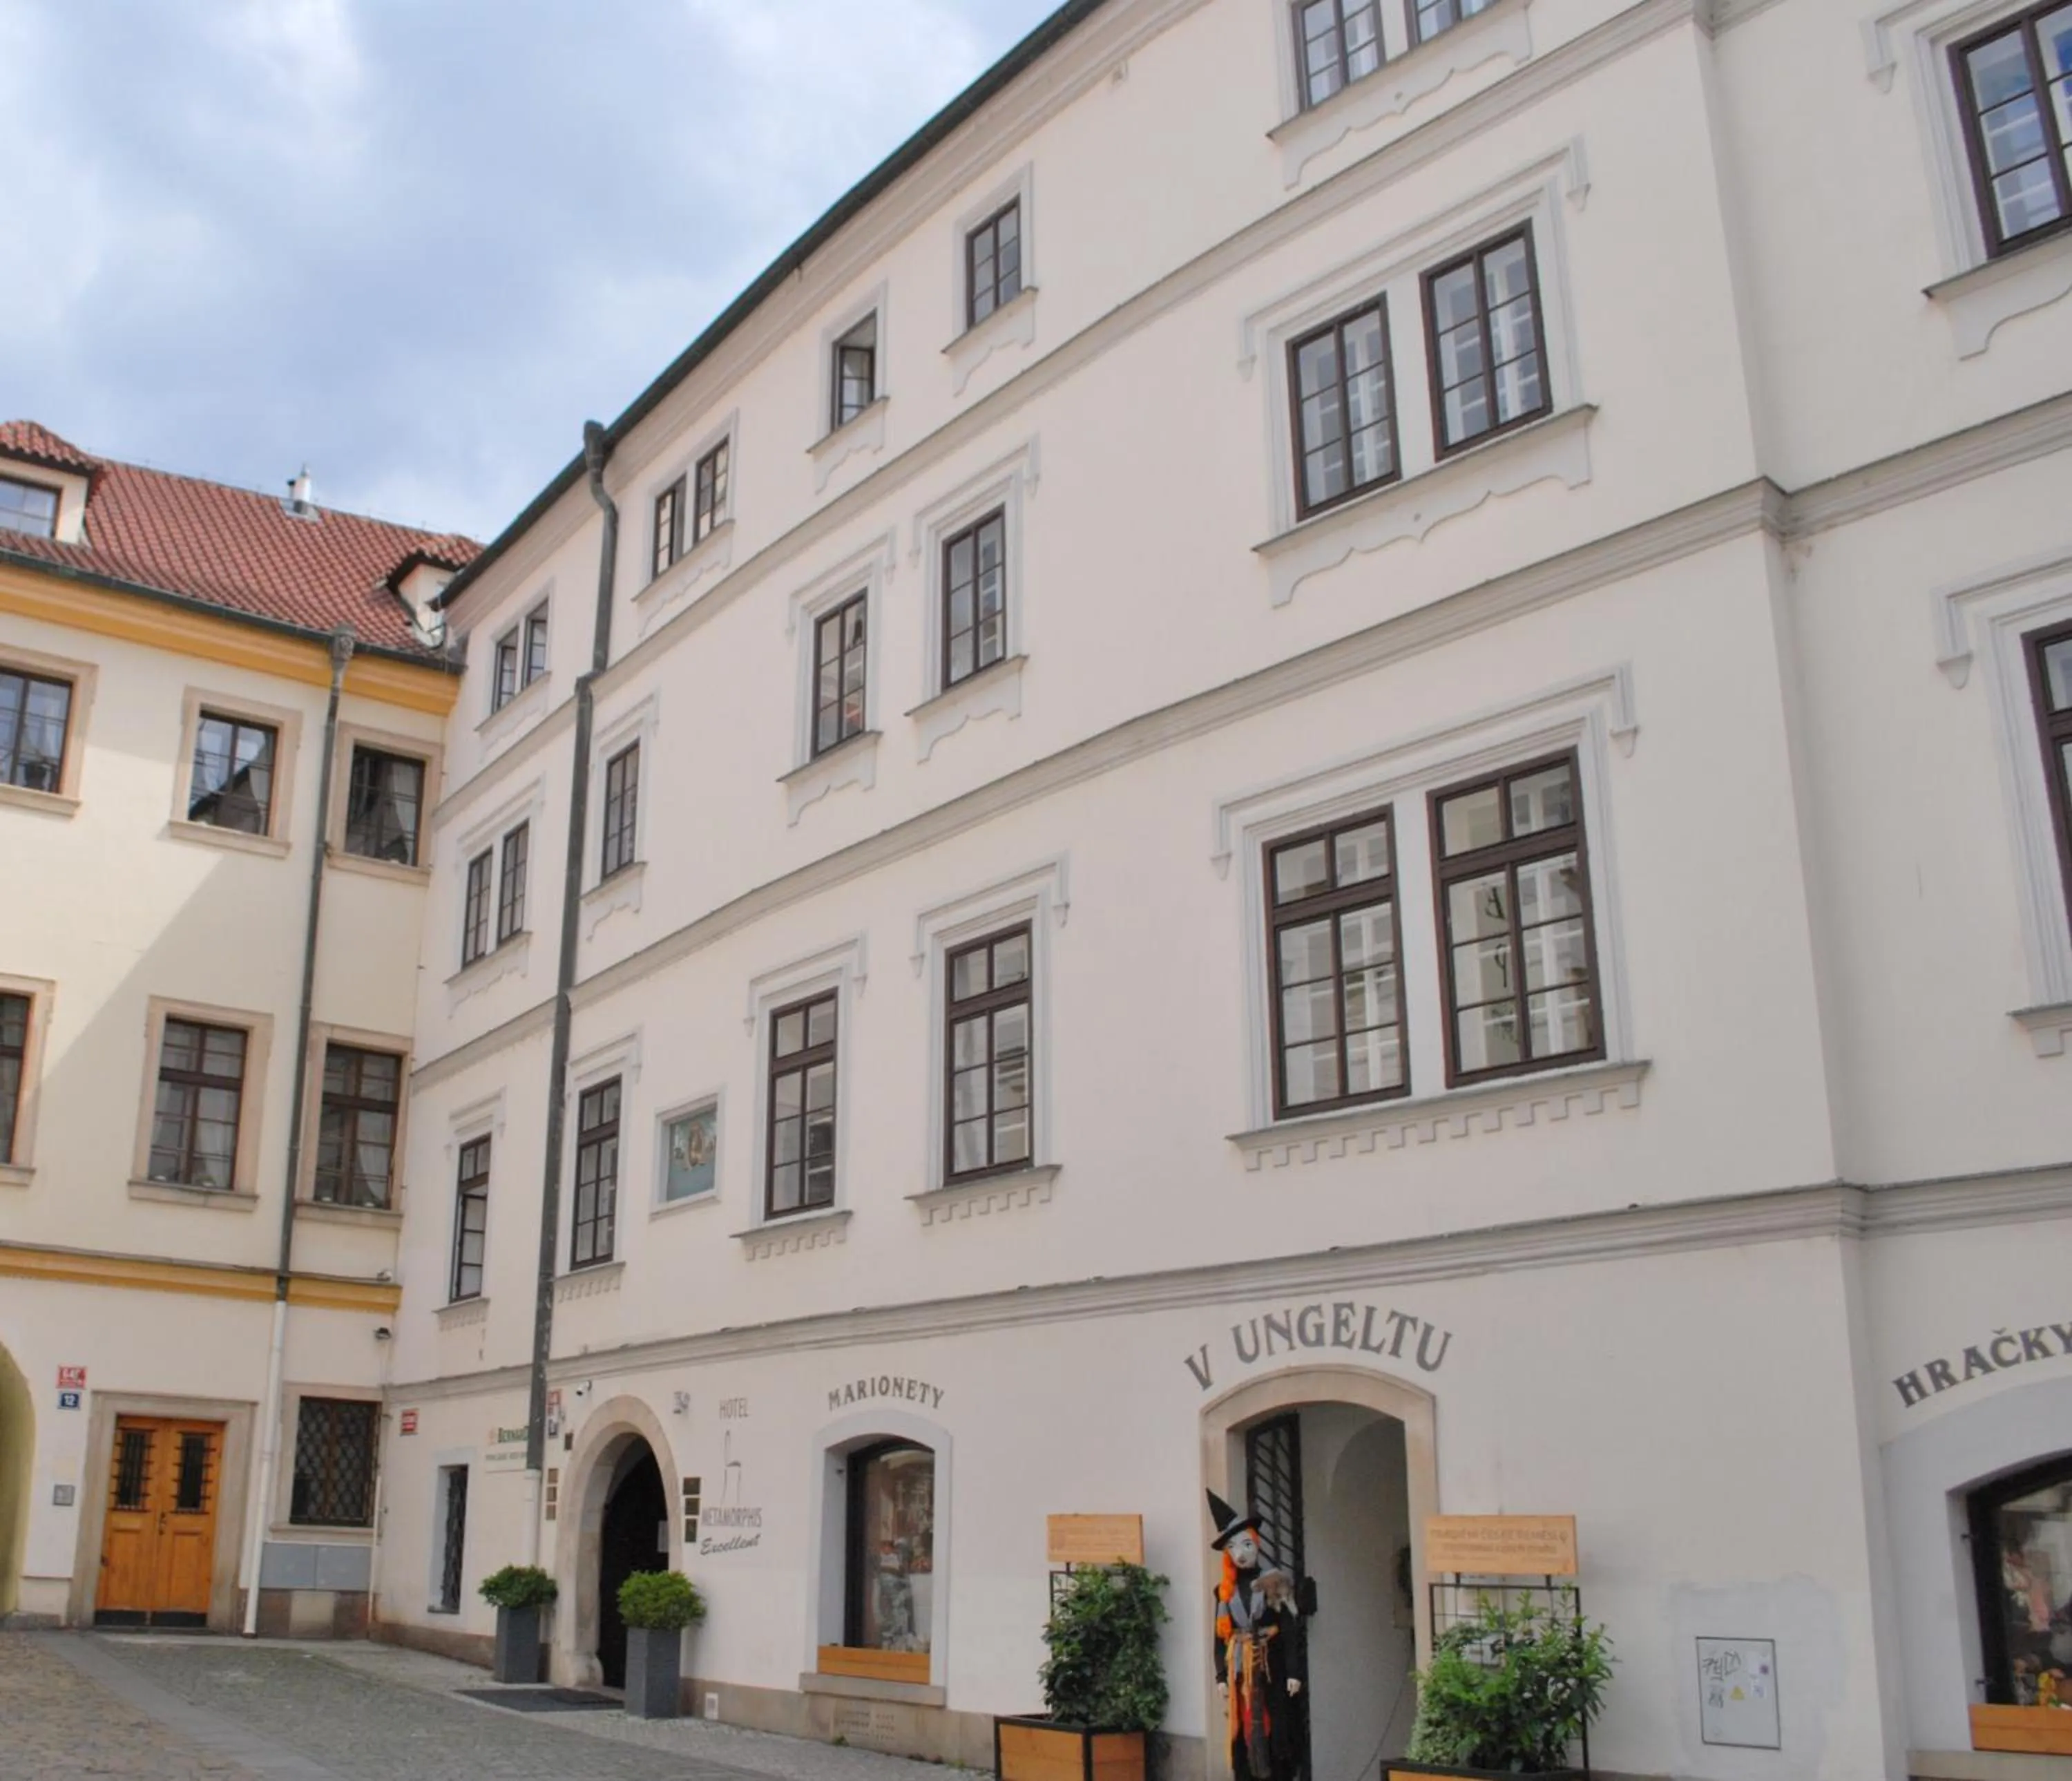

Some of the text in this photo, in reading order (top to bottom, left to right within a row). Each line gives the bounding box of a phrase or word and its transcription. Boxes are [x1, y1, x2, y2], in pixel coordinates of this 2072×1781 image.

[1183, 1302, 1452, 1391] V UNGELTU
[1892, 1321, 2072, 1409] HRAČKY
[719, 1397, 749, 1420] HOTEL
[827, 1375, 945, 1411] MARIONETY
[700, 1533, 761, 1556] Excellent
